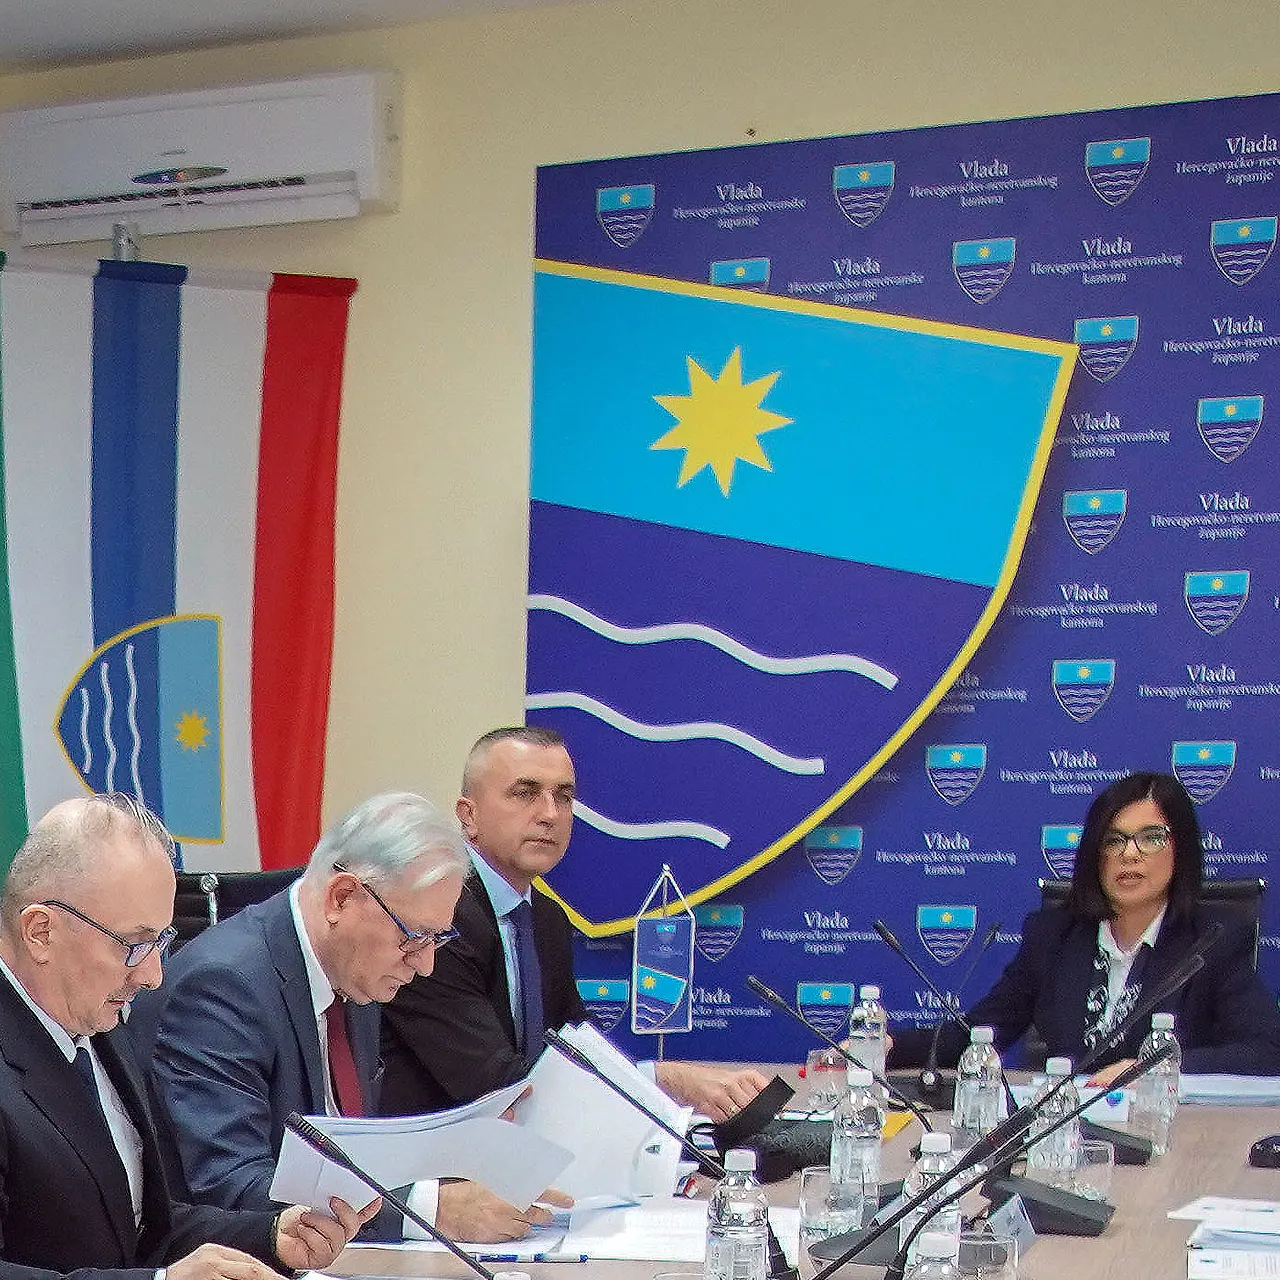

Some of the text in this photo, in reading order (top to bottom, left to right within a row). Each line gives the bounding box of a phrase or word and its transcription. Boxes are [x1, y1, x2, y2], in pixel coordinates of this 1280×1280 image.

[1226, 134, 1277, 154] Vlada
[960, 159, 1011, 178] Vlada
[716, 182, 763, 201] Vlada
[1082, 237, 1131, 256] Vlada
[833, 257, 880, 275] Vlada
[1213, 315, 1266, 335] Vlada
[1071, 411, 1121, 430] Vlada
[1199, 491, 1251, 511] Vlada
[1060, 583, 1110, 601] Vlada
[1186, 664, 1237, 682] Vlada
[1048, 749, 1098, 768] Vlada
[923, 831, 970, 850] Vlada
[804, 910, 850, 928] Vlada
